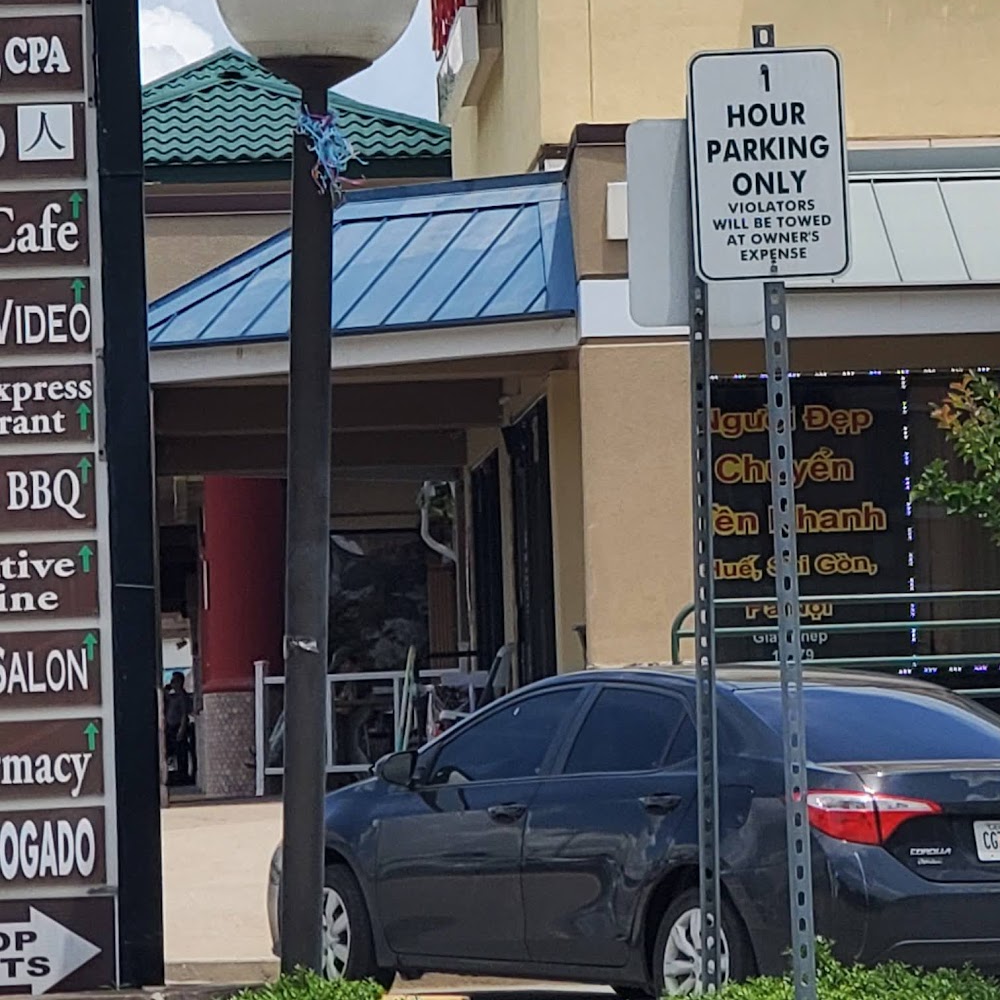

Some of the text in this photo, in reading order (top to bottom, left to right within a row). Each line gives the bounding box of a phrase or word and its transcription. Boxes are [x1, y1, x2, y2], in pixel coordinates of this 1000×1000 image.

[4, 36, 71, 74] CPA
[760, 64, 771, 92] 1
[727, 102, 806, 128] HOUR
[707, 135, 829, 163] PARKING
[732, 170, 807, 195] ONLY
[728, 200, 815, 214] VIOLATORS
[713, 215, 832, 230] WILL BE TOWED
[727, 231, 820, 246] AT OWNER'S
[740, 248, 807, 261] EXPENSE
[0, 411, 66, 434] rant
[802, 405, 873, 435] Đẹp
[714, 446, 854, 489] Chyển
[6, 469, 86, 519] BBQ
[768, 502, 887, 534] hanh
[0, 549, 76, 579] tive
[0, 752, 92, 797] macy
[0, 817, 95, 880] OGADO
[0, 956, 51, 977] TS
